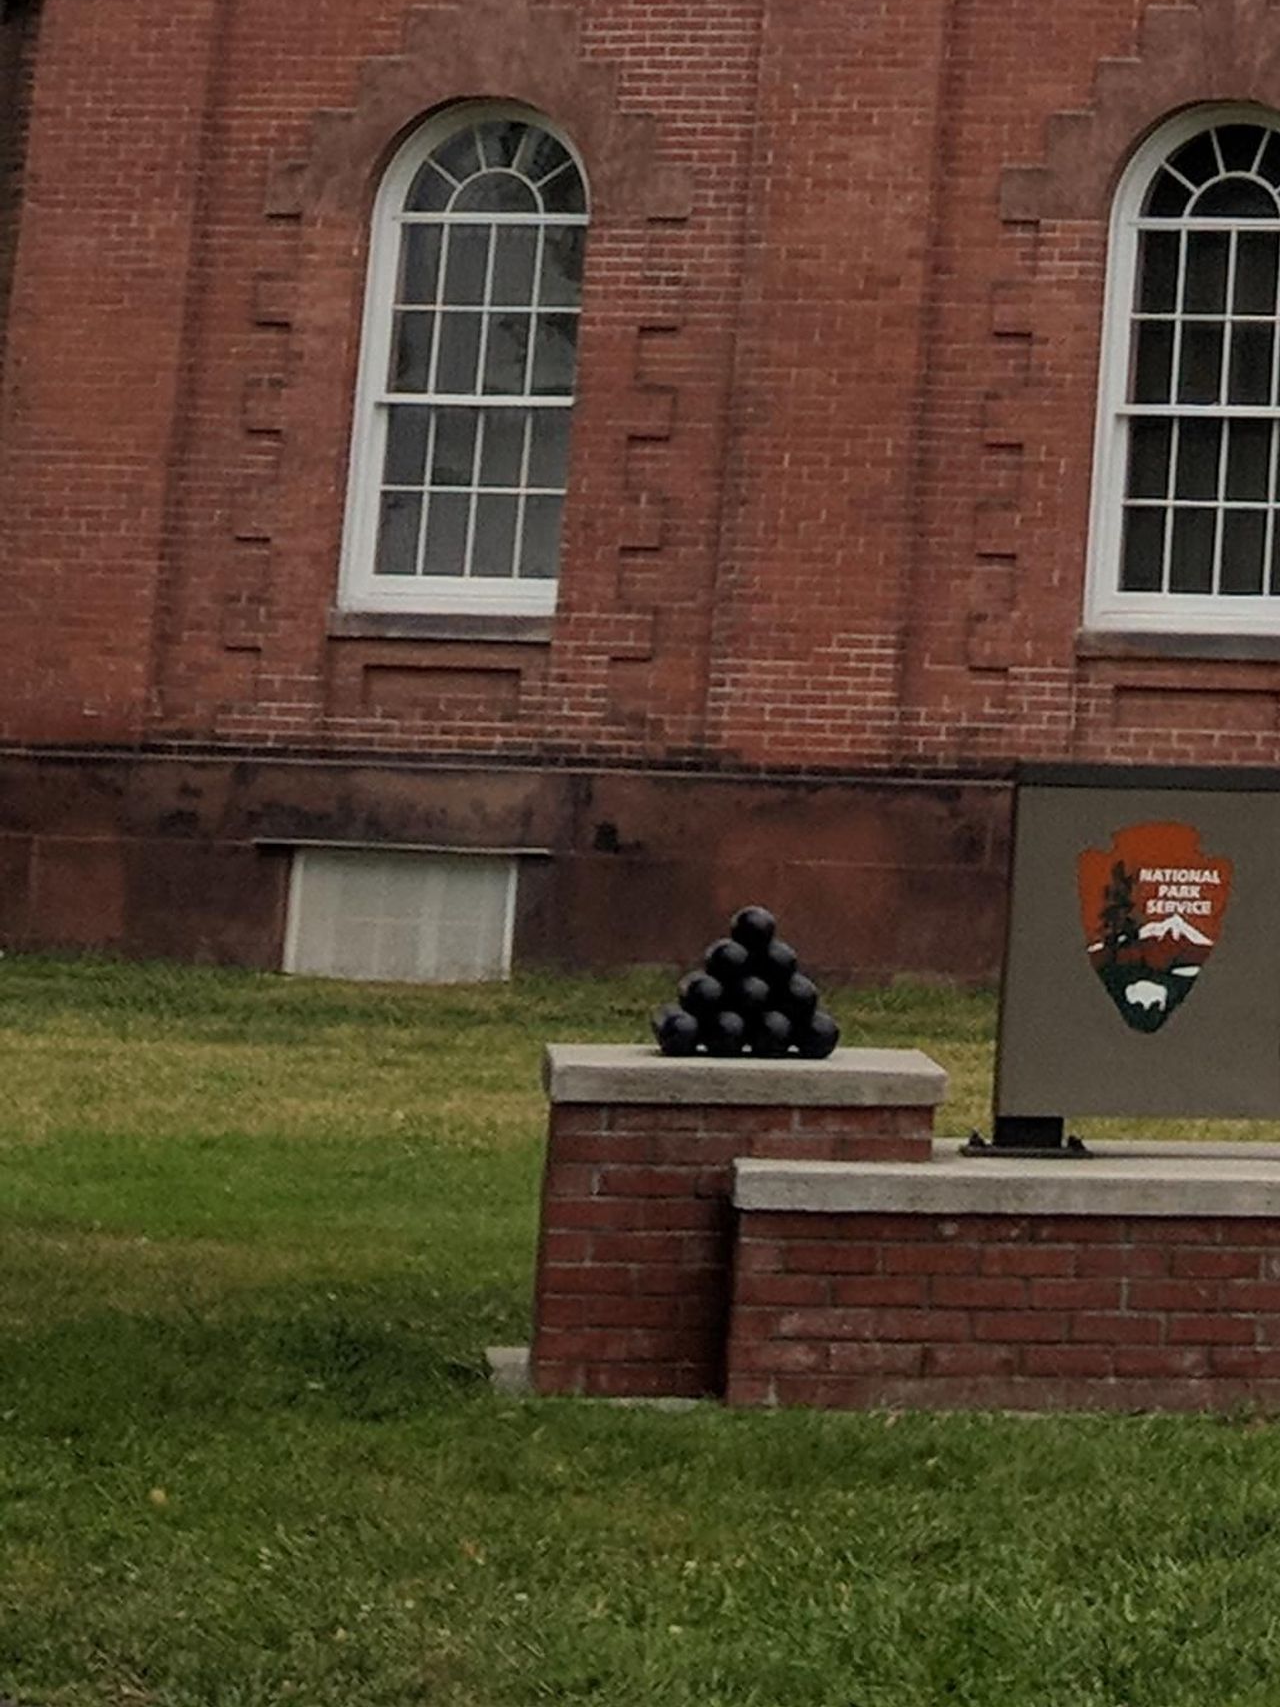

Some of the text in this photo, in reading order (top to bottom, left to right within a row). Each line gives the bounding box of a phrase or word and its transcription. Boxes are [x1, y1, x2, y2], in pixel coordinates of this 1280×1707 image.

[1140, 868, 1221, 884] NATIONAL
[1158, 885, 1201, 899] PARK
[1146, 899, 1212, 915] SERVICE
